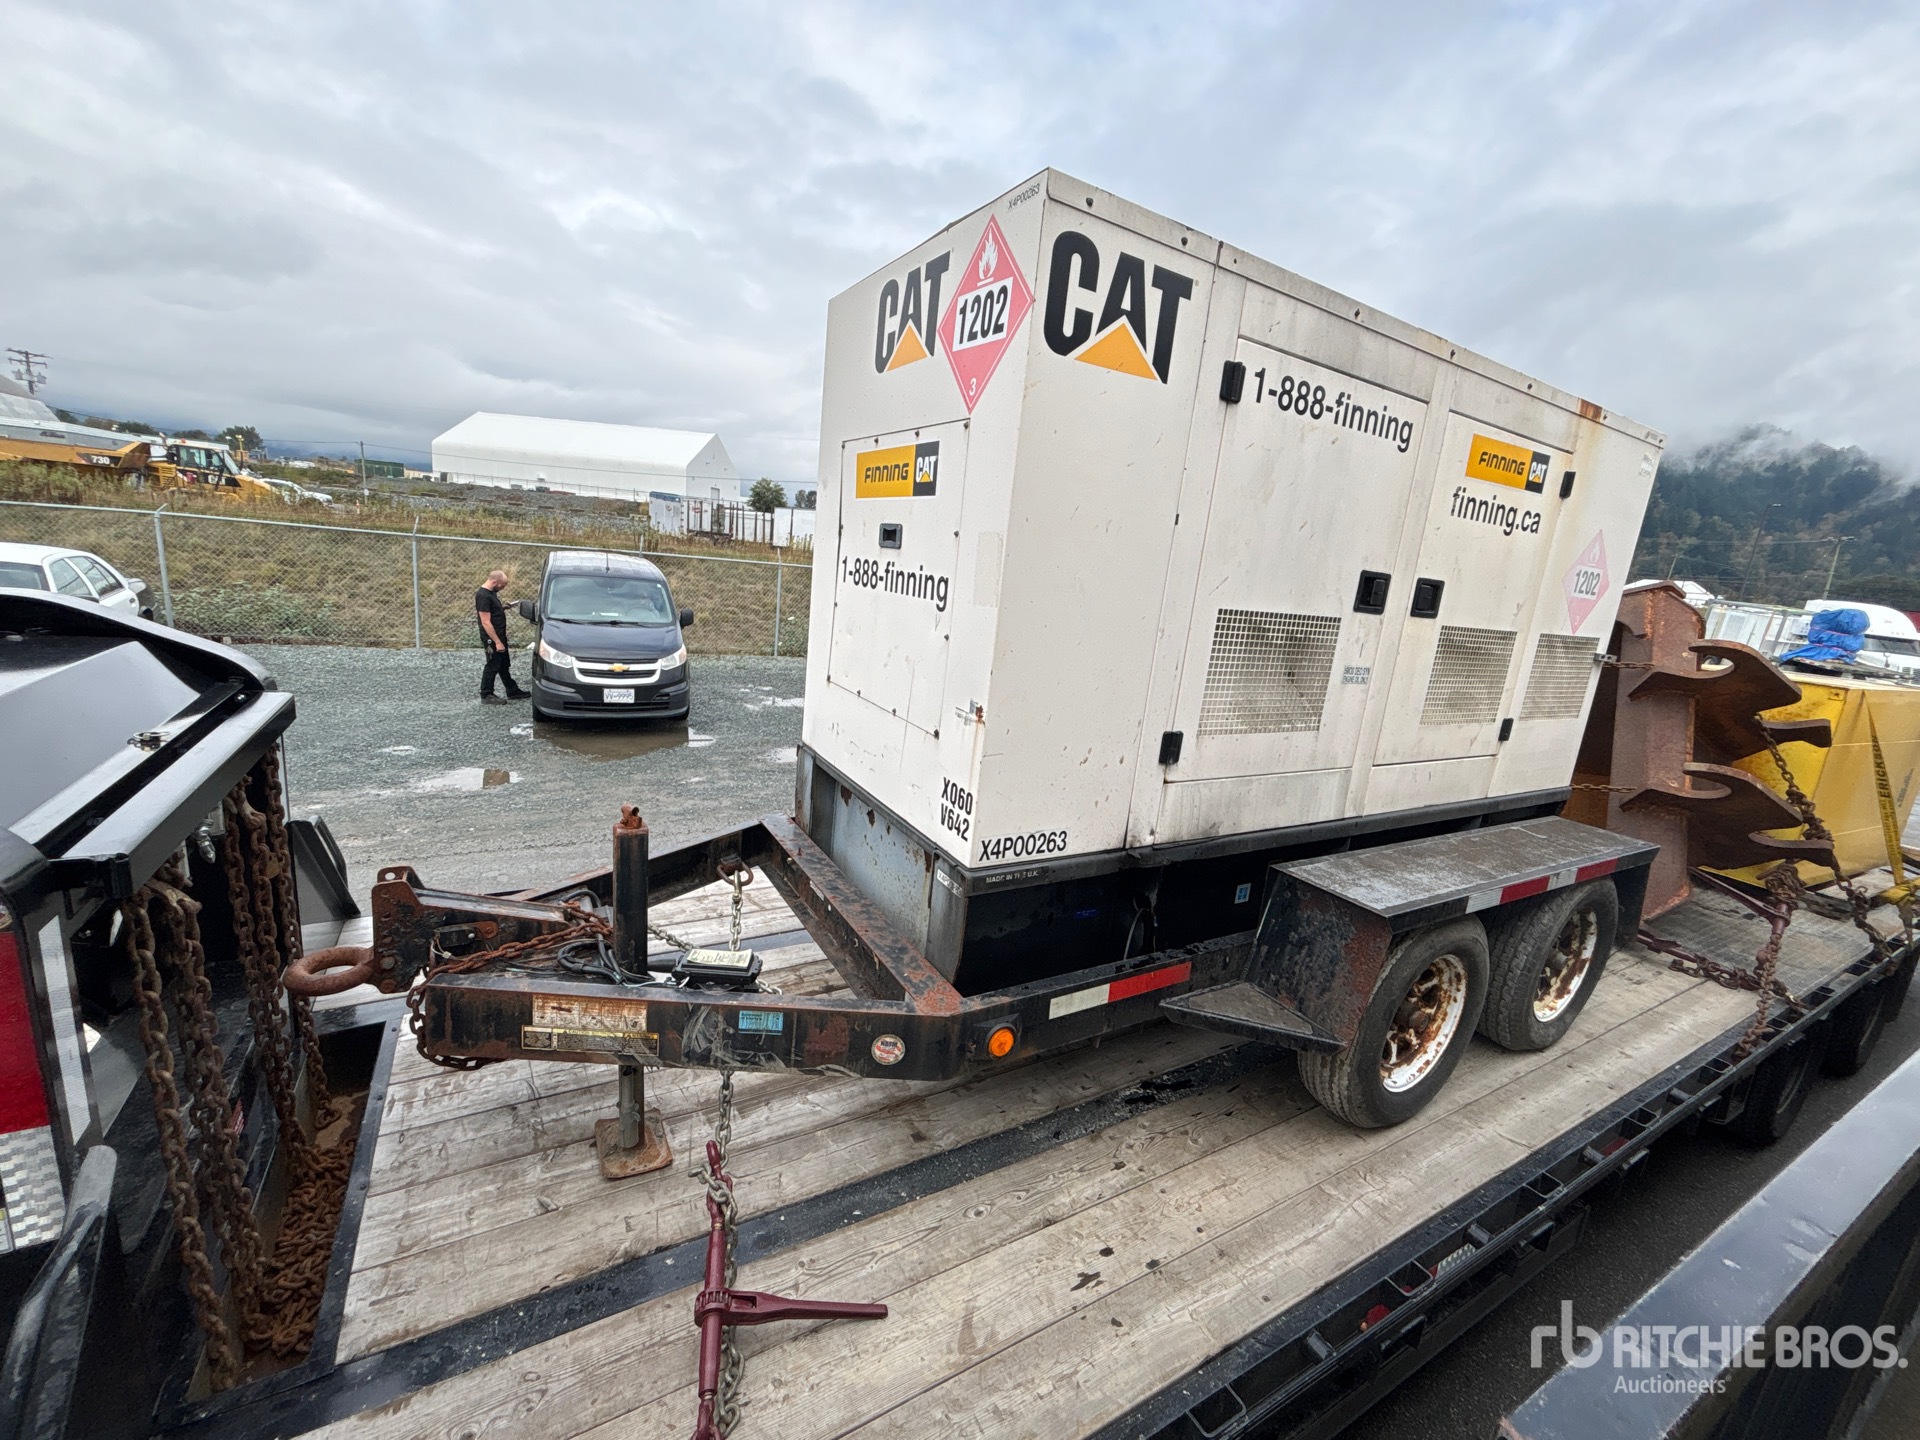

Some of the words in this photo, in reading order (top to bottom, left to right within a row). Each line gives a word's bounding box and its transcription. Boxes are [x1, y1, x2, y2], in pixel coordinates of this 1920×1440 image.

[875, 249, 951, 374] CAT
[959, 285, 1008, 345] 1202
[1044, 231, 1193, 384] CAT
[969, 378, 977, 395] 3
[1254, 367, 1414, 453] 1-888-finning
[91, 455, 110, 465] 730
[864, 463, 909, 484] FINNING
[916, 455, 937, 483] CAT
[1478, 451, 1526, 476] FINNING
[1529, 461, 1547, 484] CAT
[1450, 486, 1541, 536] finning.ca
[841, 555, 949, 612] 1-888-finning
[1573, 569, 1601, 596] 1202
[941, 776, 973, 815] XQ60
[941, 803, 969, 842] V642
[979, 830, 1067, 861] X4P00263
